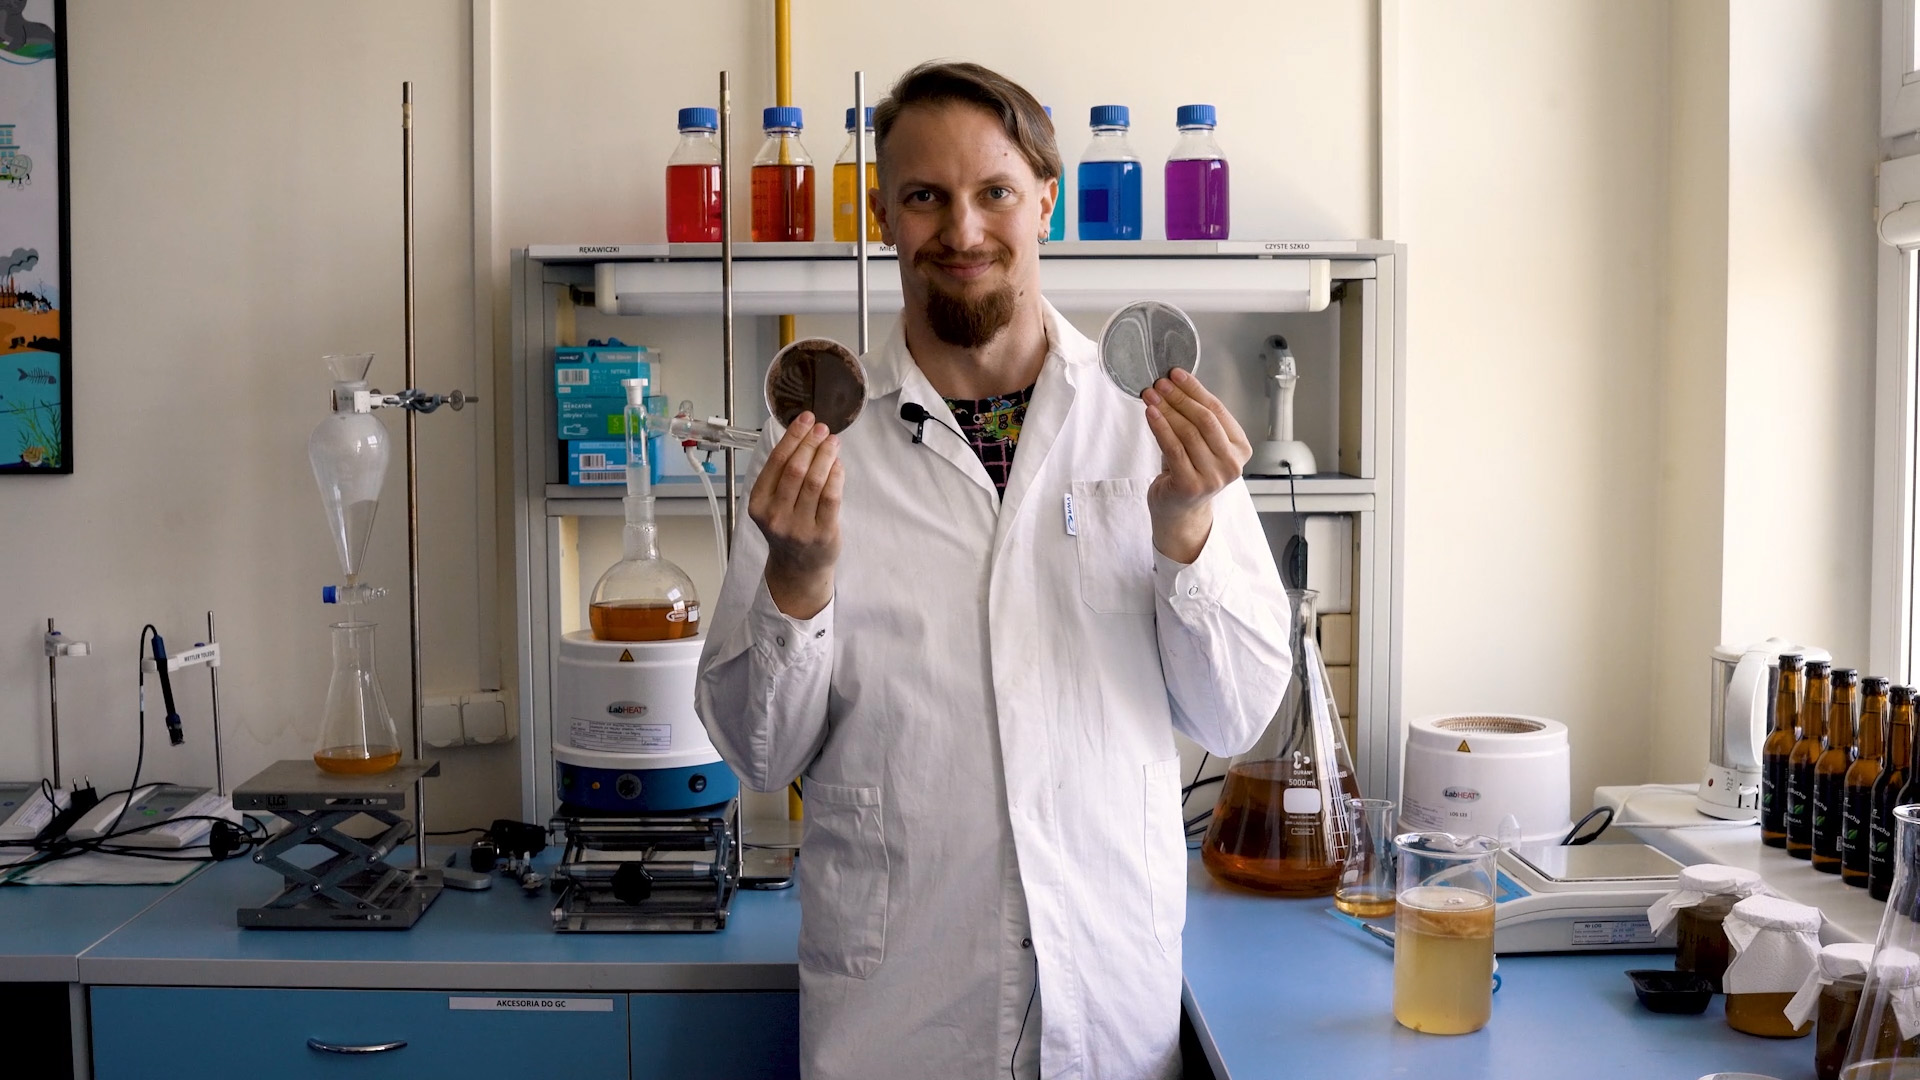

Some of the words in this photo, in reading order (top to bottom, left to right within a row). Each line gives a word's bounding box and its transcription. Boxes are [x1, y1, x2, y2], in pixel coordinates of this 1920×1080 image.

[578, 246, 620, 254] RĘKAWICZKI
[563, 402, 592, 410] MERCATOR
[1288, 778, 1306, 786] 5000
[541, 1000, 553, 1008] DO
